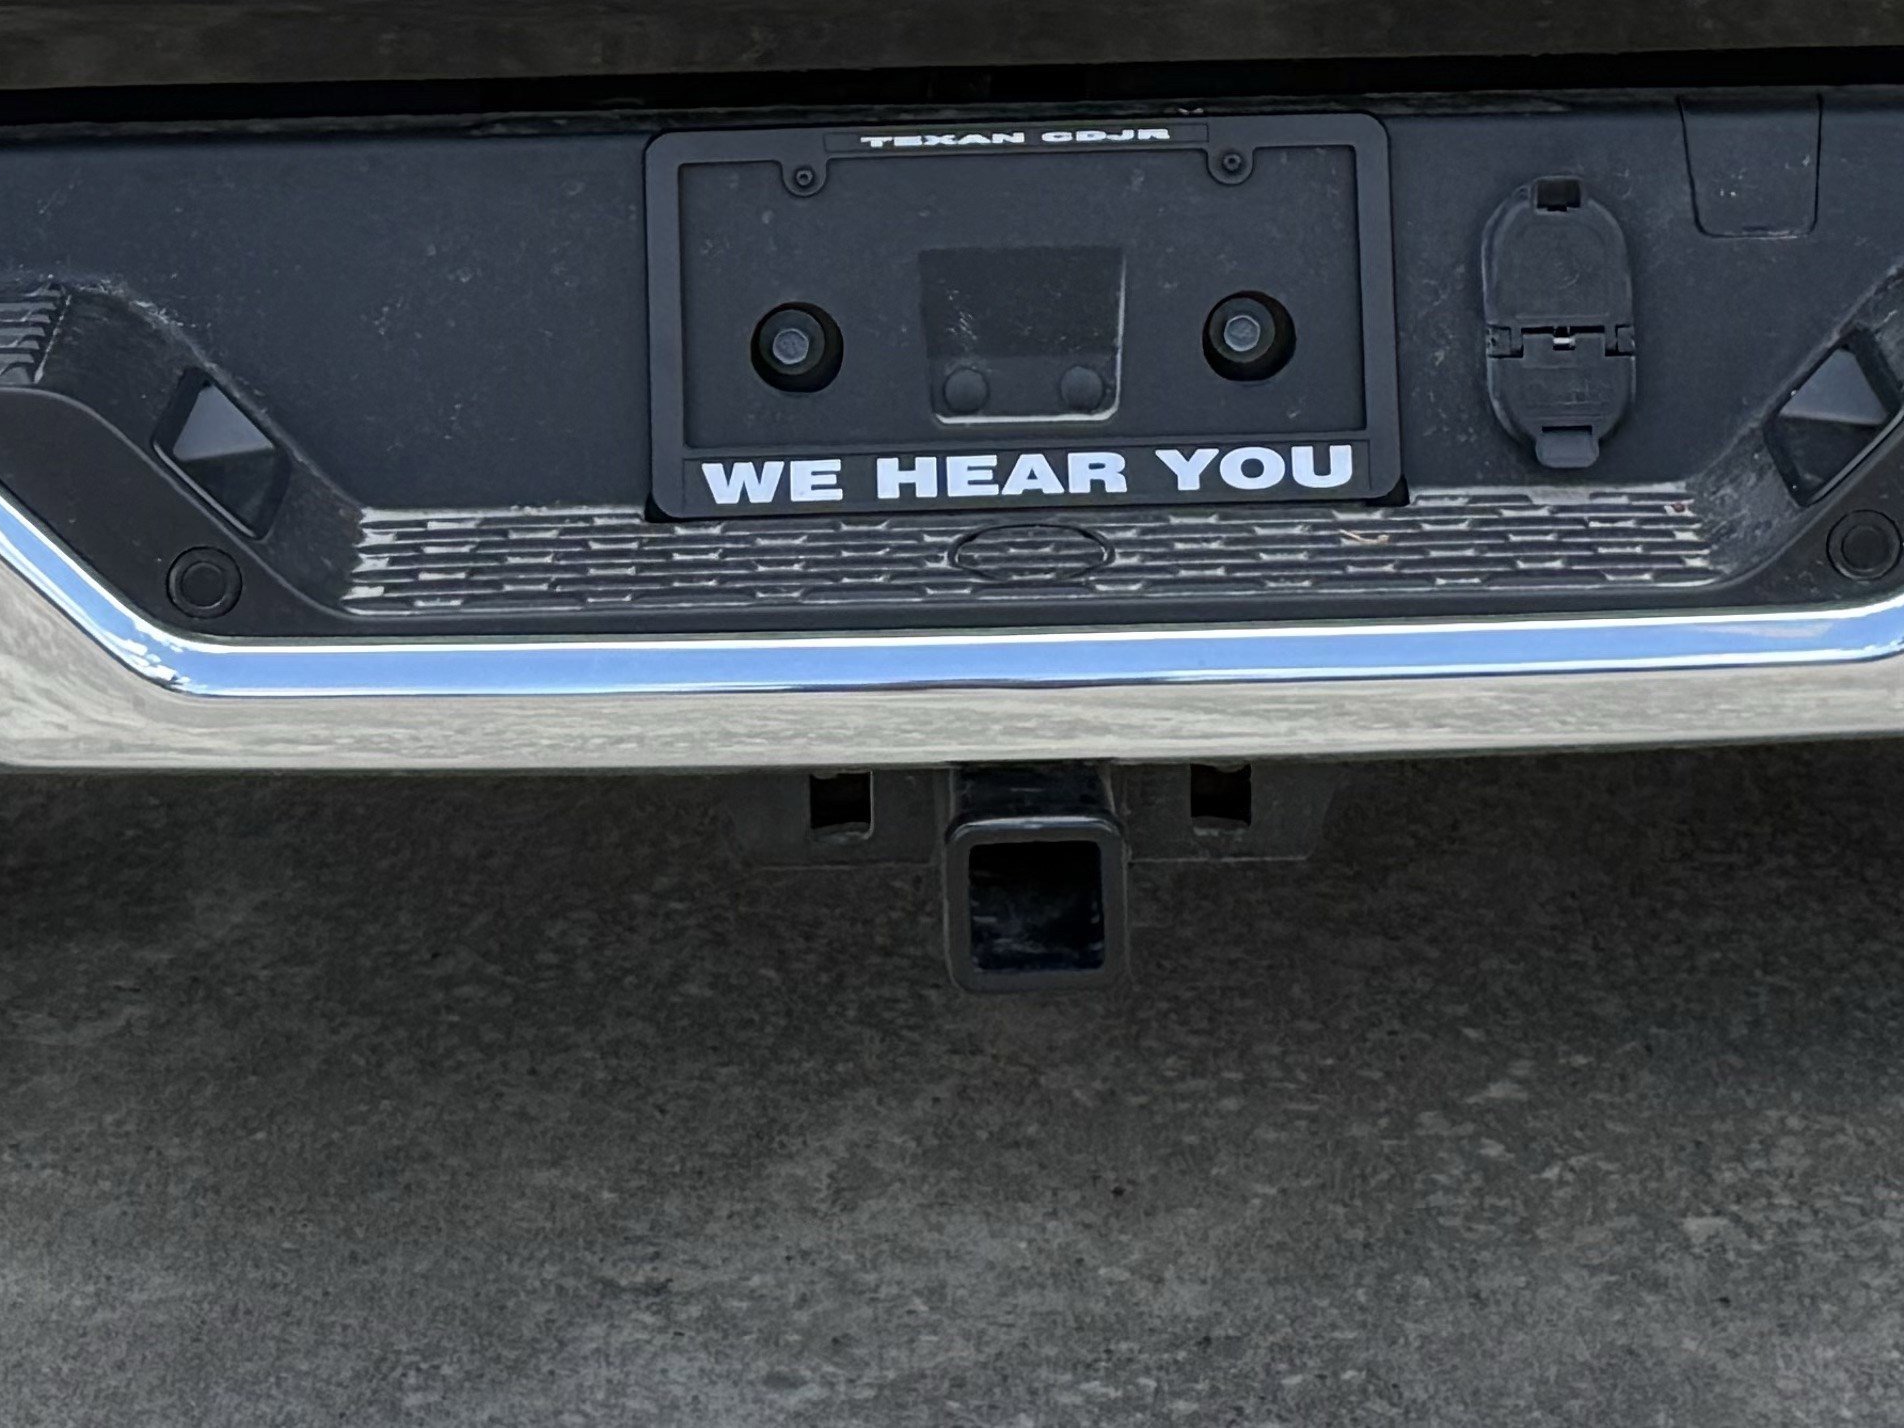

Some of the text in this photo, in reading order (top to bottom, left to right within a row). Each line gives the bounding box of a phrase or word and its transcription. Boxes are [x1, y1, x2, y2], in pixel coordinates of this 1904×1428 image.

[860, 128, 1171, 148] TEXAN CDJR
[701, 444, 1353, 505] WE HEAR YOU
